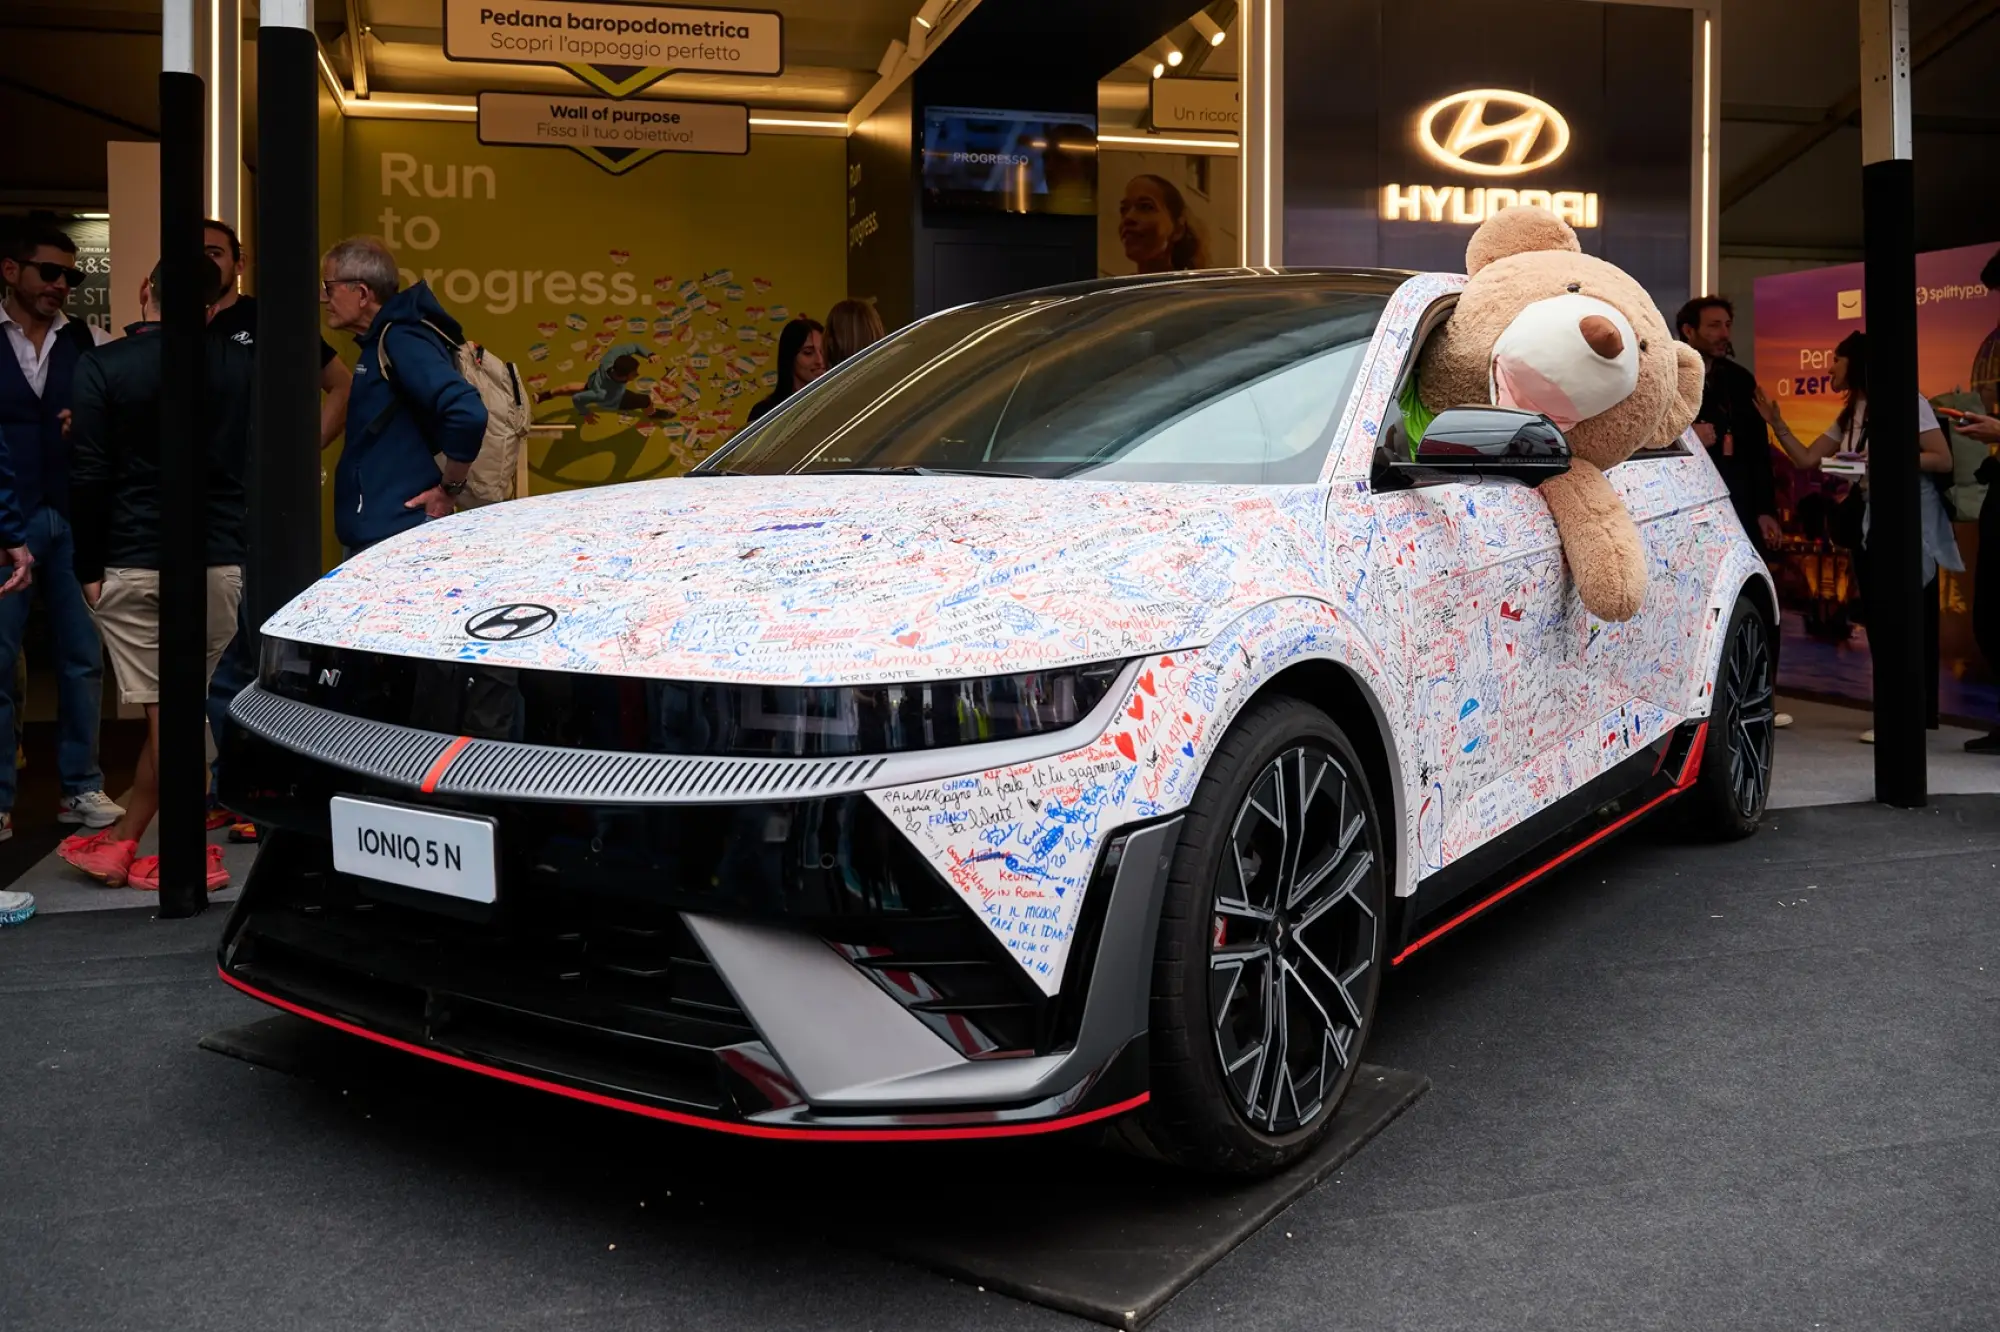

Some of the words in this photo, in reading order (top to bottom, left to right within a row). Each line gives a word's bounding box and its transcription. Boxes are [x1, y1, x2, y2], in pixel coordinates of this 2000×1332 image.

[480, 8, 562, 30] Pedana
[567, 13, 750, 40] baropodometrica
[490, 32, 554, 54] Scopri
[559, 35, 662, 60] l'appoggio
[667, 44, 741, 62] perfetto
[550, 104, 588, 120] Wall
[592, 105, 610, 121] of
[612, 109, 681, 126] purpose
[1174, 106, 1195, 121] Un
[536, 122, 577, 138] Fissa
[581, 123, 590, 139] il
[593, 126, 620, 141] tuo
[623, 128, 694, 144] obiettivo!
[953, 151, 1029, 166] PROGRESSO
[381, 151, 496, 200] Run
[378, 207, 441, 250] to
[1929, 284, 1988, 303] splittypay
[1800, 348, 1832, 370] Per
[1777, 377, 1790, 396] a
[358, 826, 421, 868] IONIQ
[426, 840, 439, 866] 5
[445, 843, 462, 871] N
